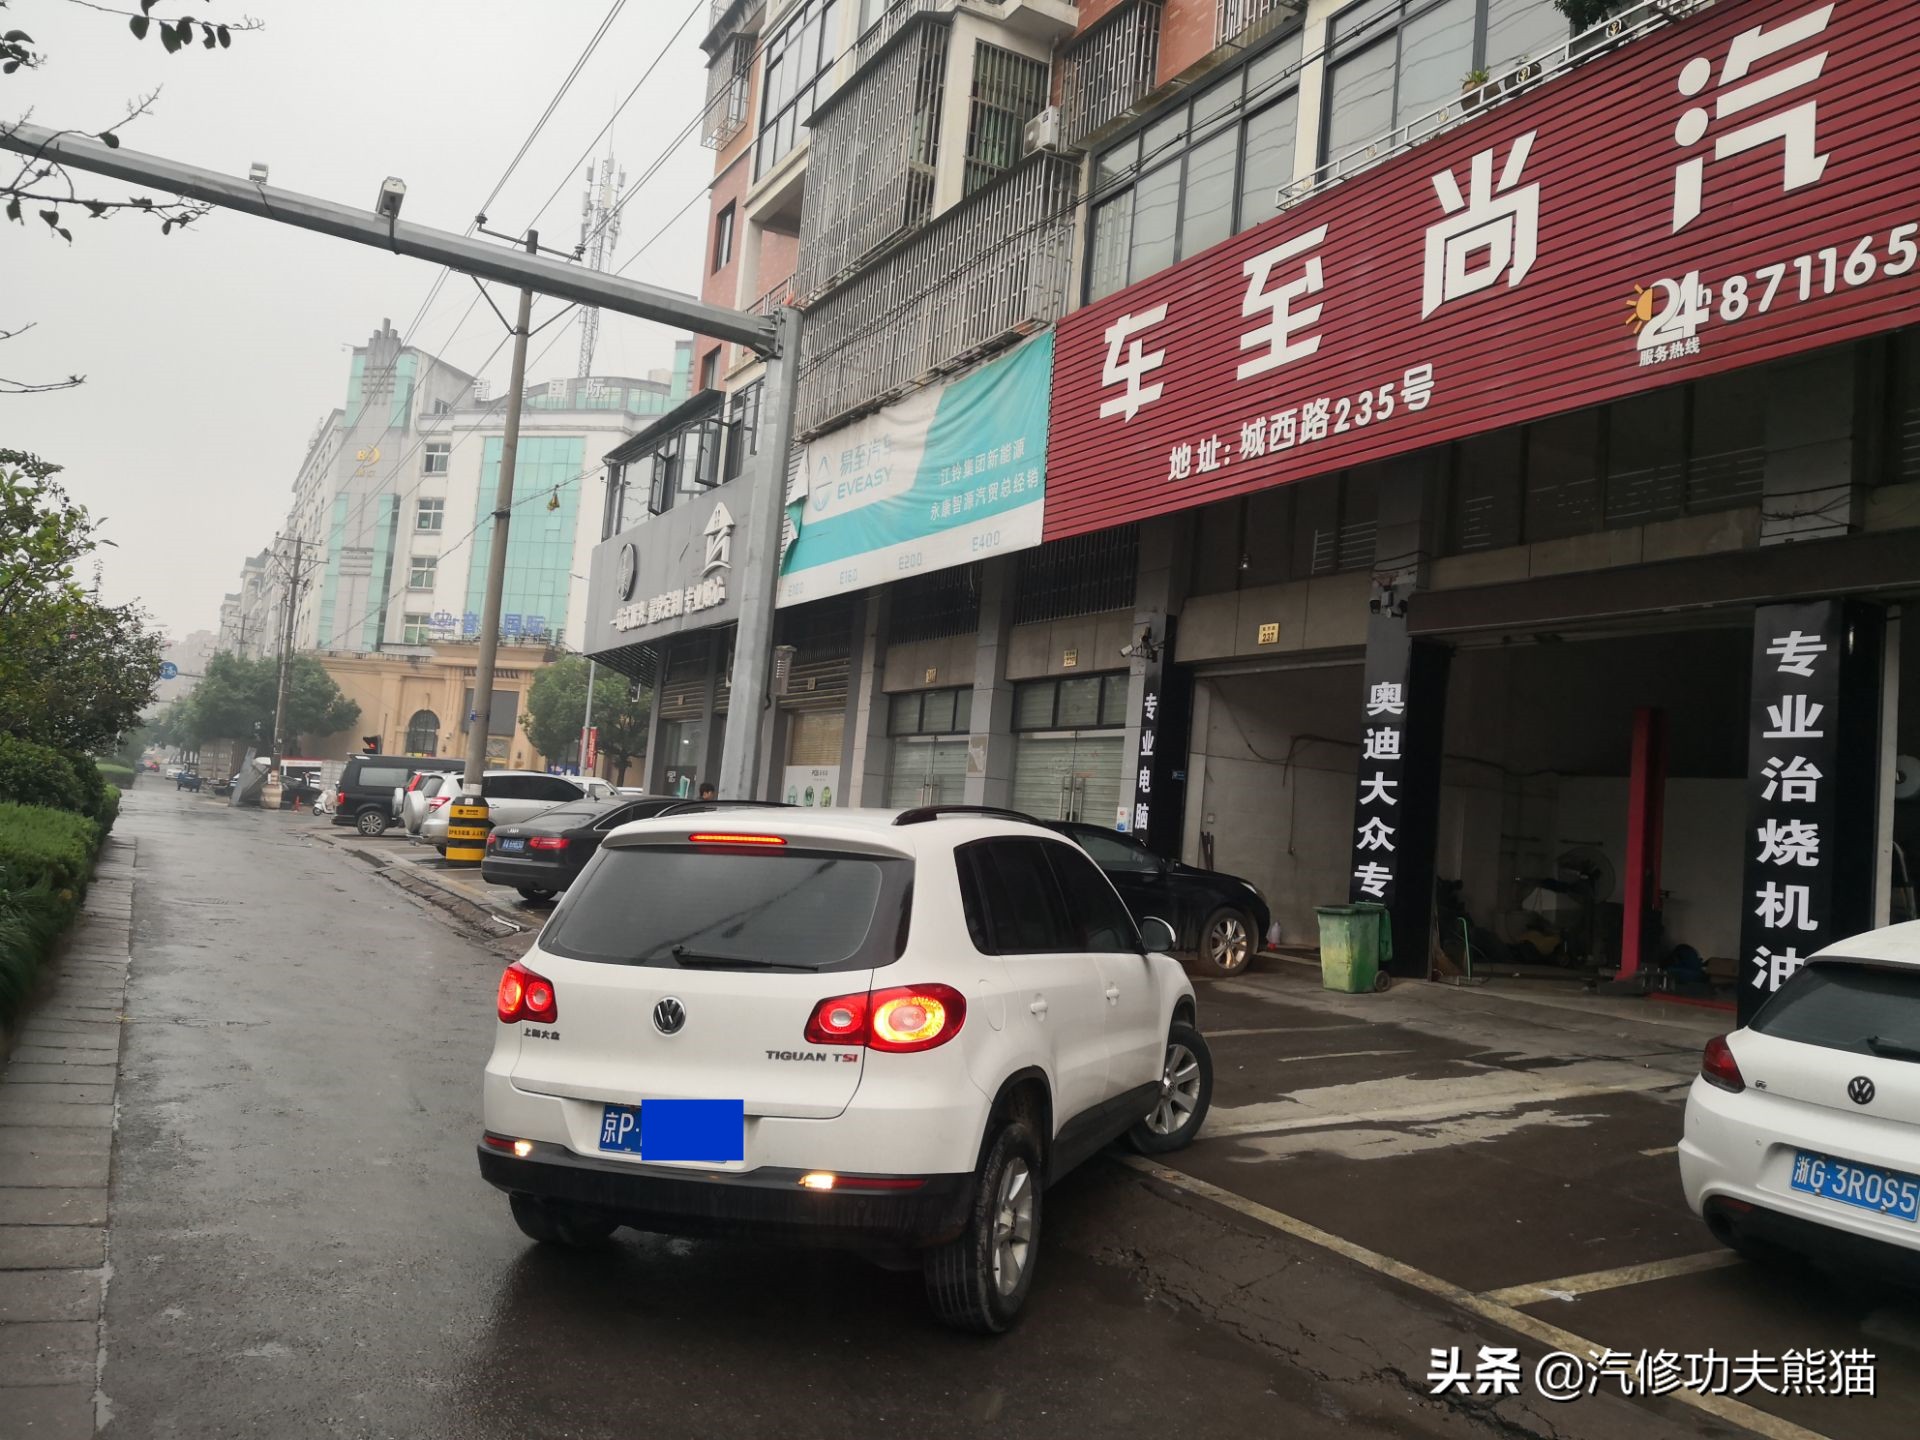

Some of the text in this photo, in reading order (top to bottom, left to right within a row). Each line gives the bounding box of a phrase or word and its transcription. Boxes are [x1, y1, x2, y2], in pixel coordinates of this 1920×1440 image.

[1099, 3, 1835, 422] 车至尚汽
[1719, 222, 1918, 321] 871165
[1639, 337, 1700, 367] 服务热线
[839, 434, 897, 477] 易至汽车
[940, 437, 1026, 487] 江铃集团新能源
[837, 465, 894, 500] EVEASY
[930, 467, 1040, 521] 永康智源汽贸总经销
[898, 552, 922, 570] E200
[972, 530, 1001, 552] E400
[1262, 632, 1275, 643] 237
[1135, 692, 1158, 831] 专业电脑
[1354, 681, 1405, 898] 奥迪大众专
[765, 1050, 859, 1063] TIGUAN TSI
